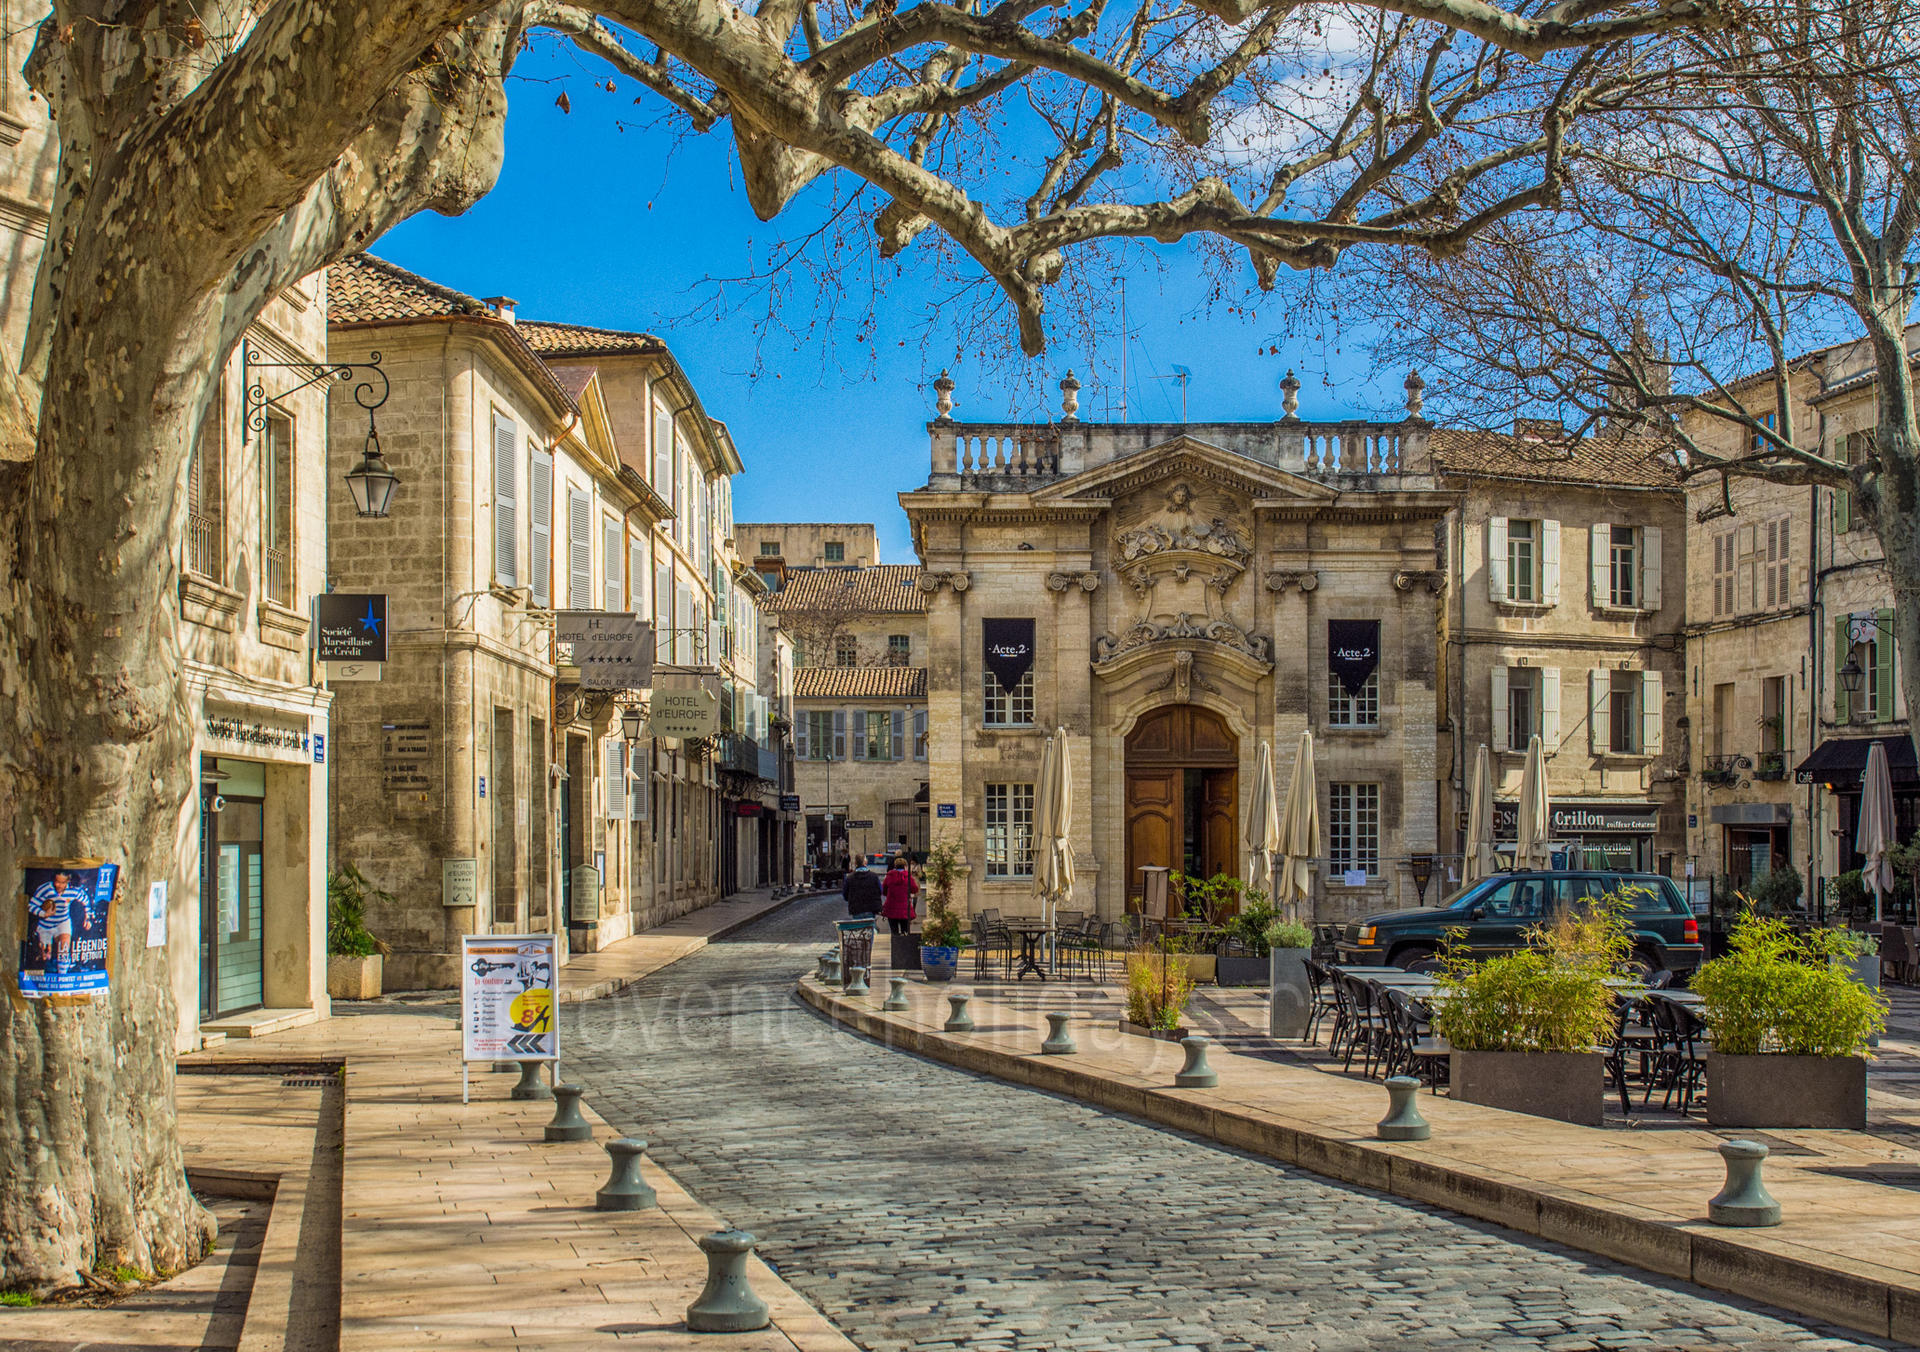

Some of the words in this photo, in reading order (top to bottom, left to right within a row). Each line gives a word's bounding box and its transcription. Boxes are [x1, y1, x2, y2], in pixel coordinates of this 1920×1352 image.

[322, 626, 352, 636] Société
[322, 637, 373, 646] Marseillaise
[558, 633, 587, 641] HOTEL
[592, 633, 633, 641] d'EUROPE
[322, 647, 333, 656] de
[334, 647, 362, 656] Crédit
[665, 697, 699, 707] HOTEL
[656, 709, 708, 720] d'EUROPE
[1554, 811, 1605, 826] Crillon
[1607, 820, 1631, 828] coiffeur
[58, 941, 70, 953] LA
[72, 936, 108, 953] LÉGENDE
